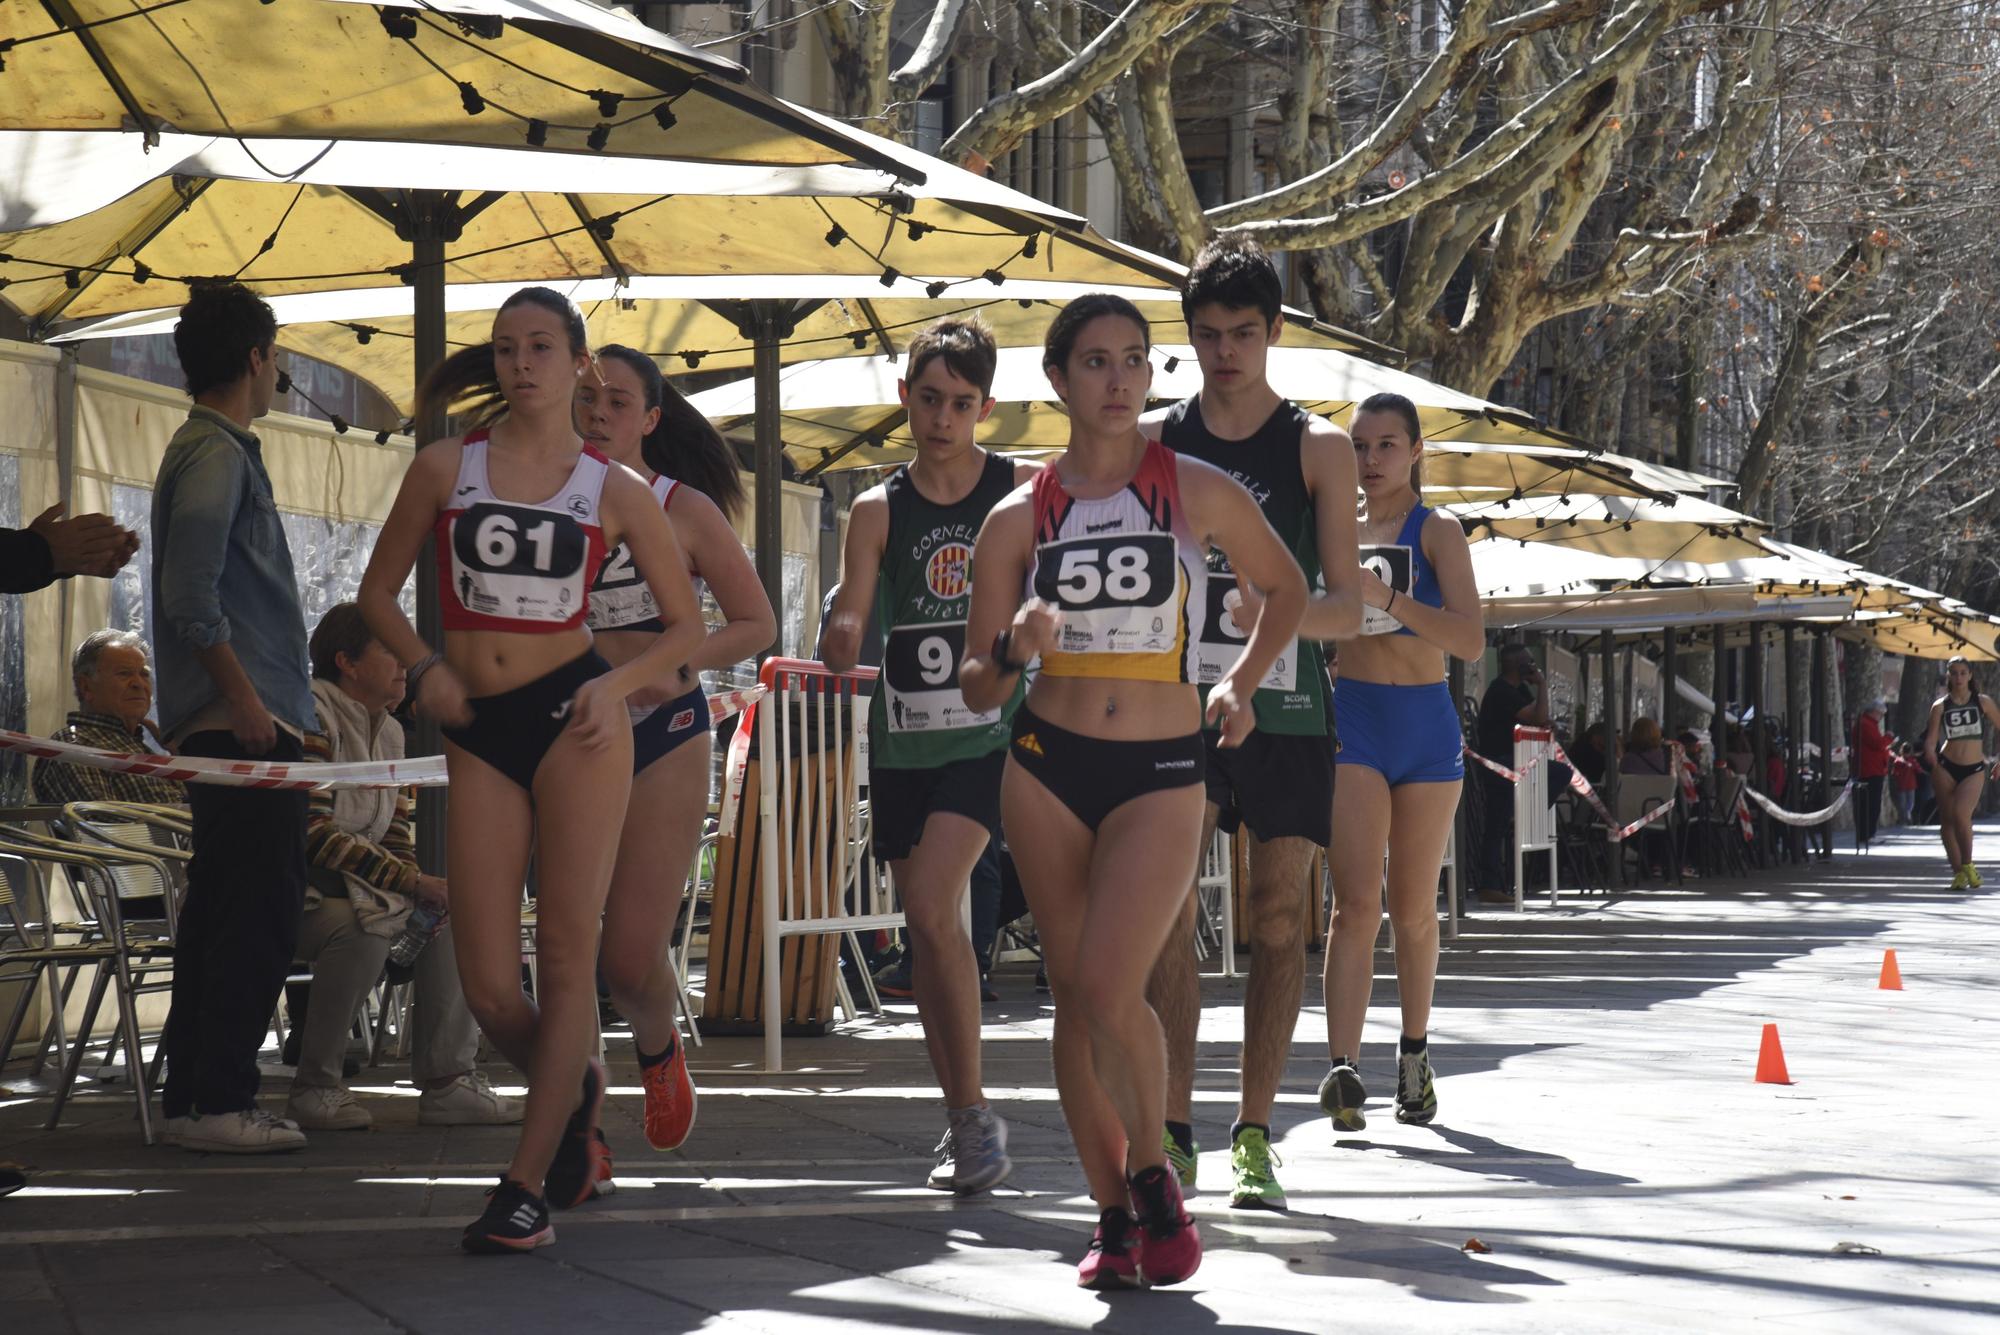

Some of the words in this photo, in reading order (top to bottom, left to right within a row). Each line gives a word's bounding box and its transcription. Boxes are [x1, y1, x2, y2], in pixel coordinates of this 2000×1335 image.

[475, 514, 556, 571] 61
[1056, 545, 1152, 604] 58
[917, 635, 953, 685] 9
[1950, 710, 1972, 725] 51
